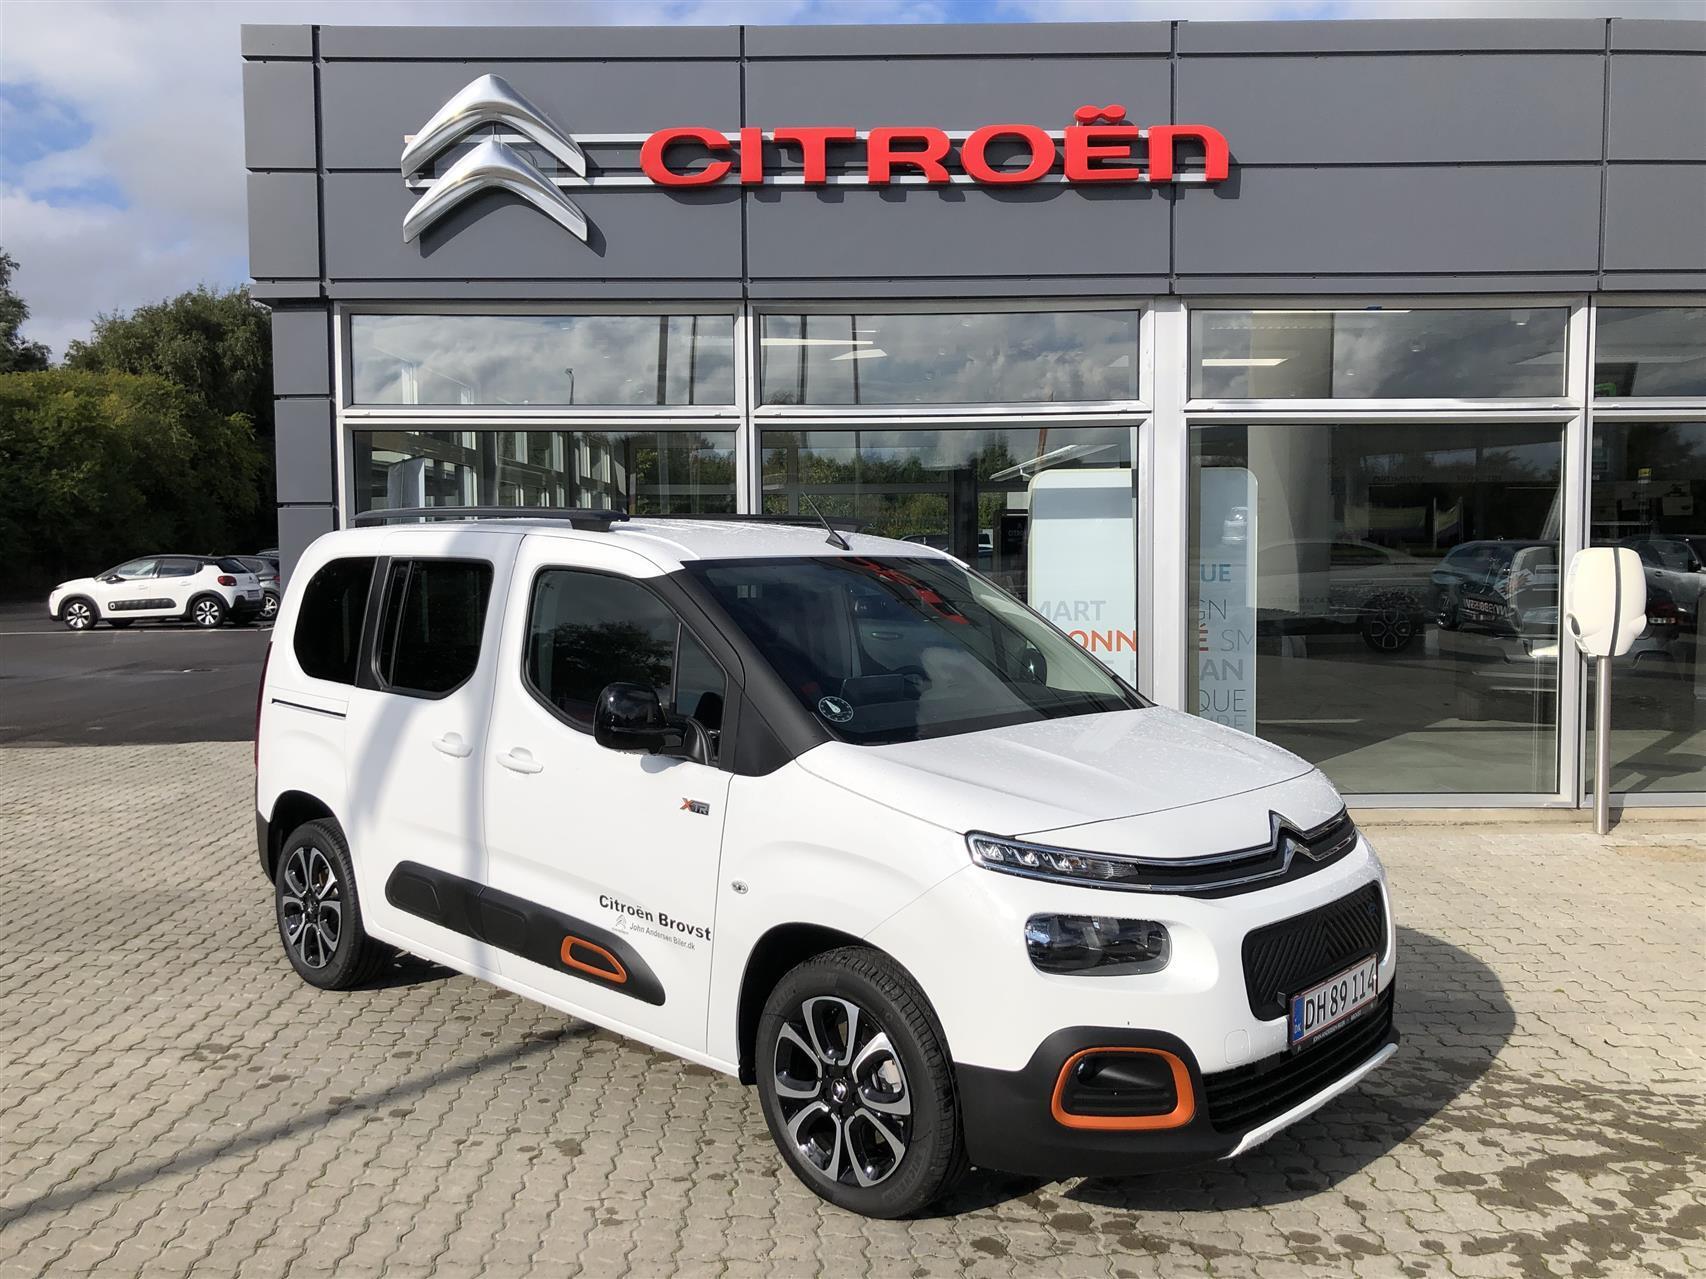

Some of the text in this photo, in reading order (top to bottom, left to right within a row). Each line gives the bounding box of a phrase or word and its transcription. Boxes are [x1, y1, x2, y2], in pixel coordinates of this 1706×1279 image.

[640, 104, 1230, 188] CITROËN
[599, 895, 654, 922] Citroën
[630, 922, 645, 933] John
[658, 912, 711, 941] Brovst
[1305, 991, 1326, 1030] DH
[1330, 980, 1347, 1017] 89
[1352, 962, 1375, 1004] 114
